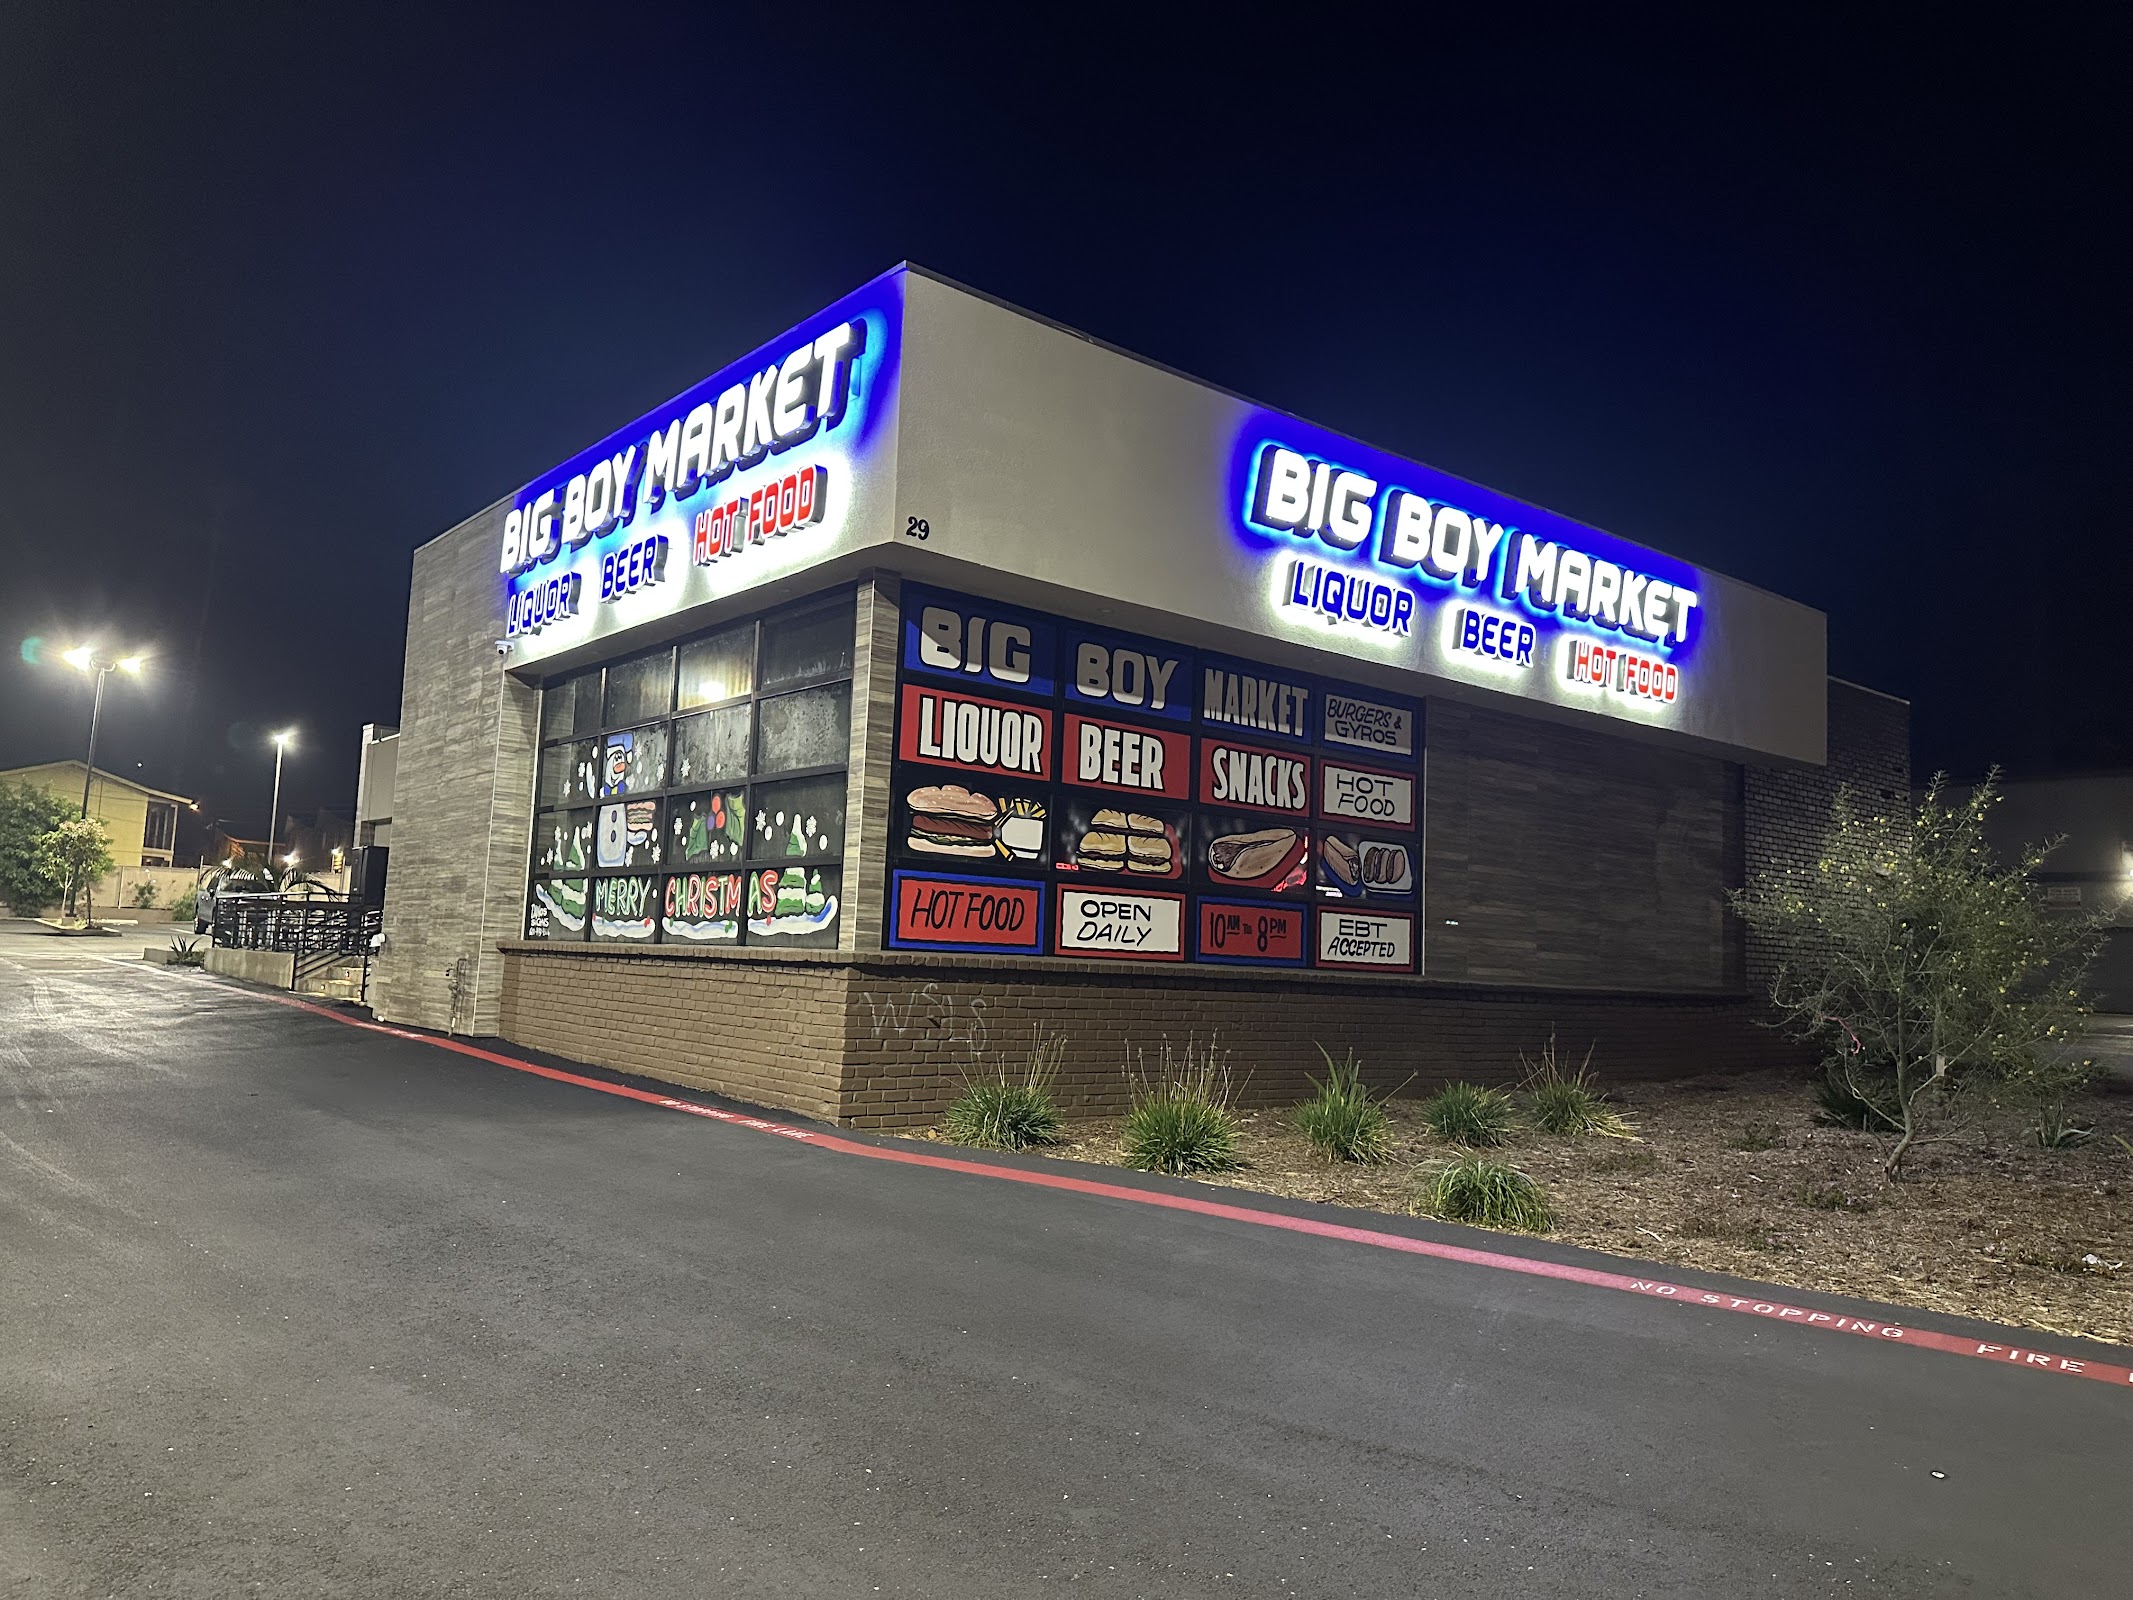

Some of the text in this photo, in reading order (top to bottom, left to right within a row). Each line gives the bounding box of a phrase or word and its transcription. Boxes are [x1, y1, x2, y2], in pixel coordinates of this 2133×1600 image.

[500, 322, 852, 574] BIG BOY MARKET
[692, 465, 816, 566] HOT FOOD
[906, 516, 930, 541] 29
[1264, 448, 1697, 643] BIG BOY MARKET
[600, 537, 658, 603] BEER
[1291, 560, 1416, 638] LIQUOR
[506, 572, 571, 638] LIQUOR
[1461, 607, 1537, 668] BEER
[920, 606, 1032, 683] BIG
[1076, 642, 1180, 710] BOY
[1572, 638, 1680, 705] HOT FOOD
[1203, 667, 1309, 737] MARKET
[1326, 698, 1403, 730] BURGERS &
[1335, 720, 1397, 746] GYROS
[919, 697, 1043, 773] LIQUOR
[1078, 723, 1165, 790] BEER
[1212, 747, 1306, 811] SNACKS
[1336, 773, 1394, 797] HOT
[1338, 793, 1396, 817] FOOD
[595, 875, 652, 918] MERRY
[910, 888, 1025, 932] HOT FOOD
[1080, 899, 1152, 922] OPEN
[1339, 918, 1388, 939] EBT
[1076, 921, 1152, 947] DAILY
[1327, 936, 1396, 957] ACCEPTED
[1630, 1280, 2085, 1373] NO STOPPING FIRE
